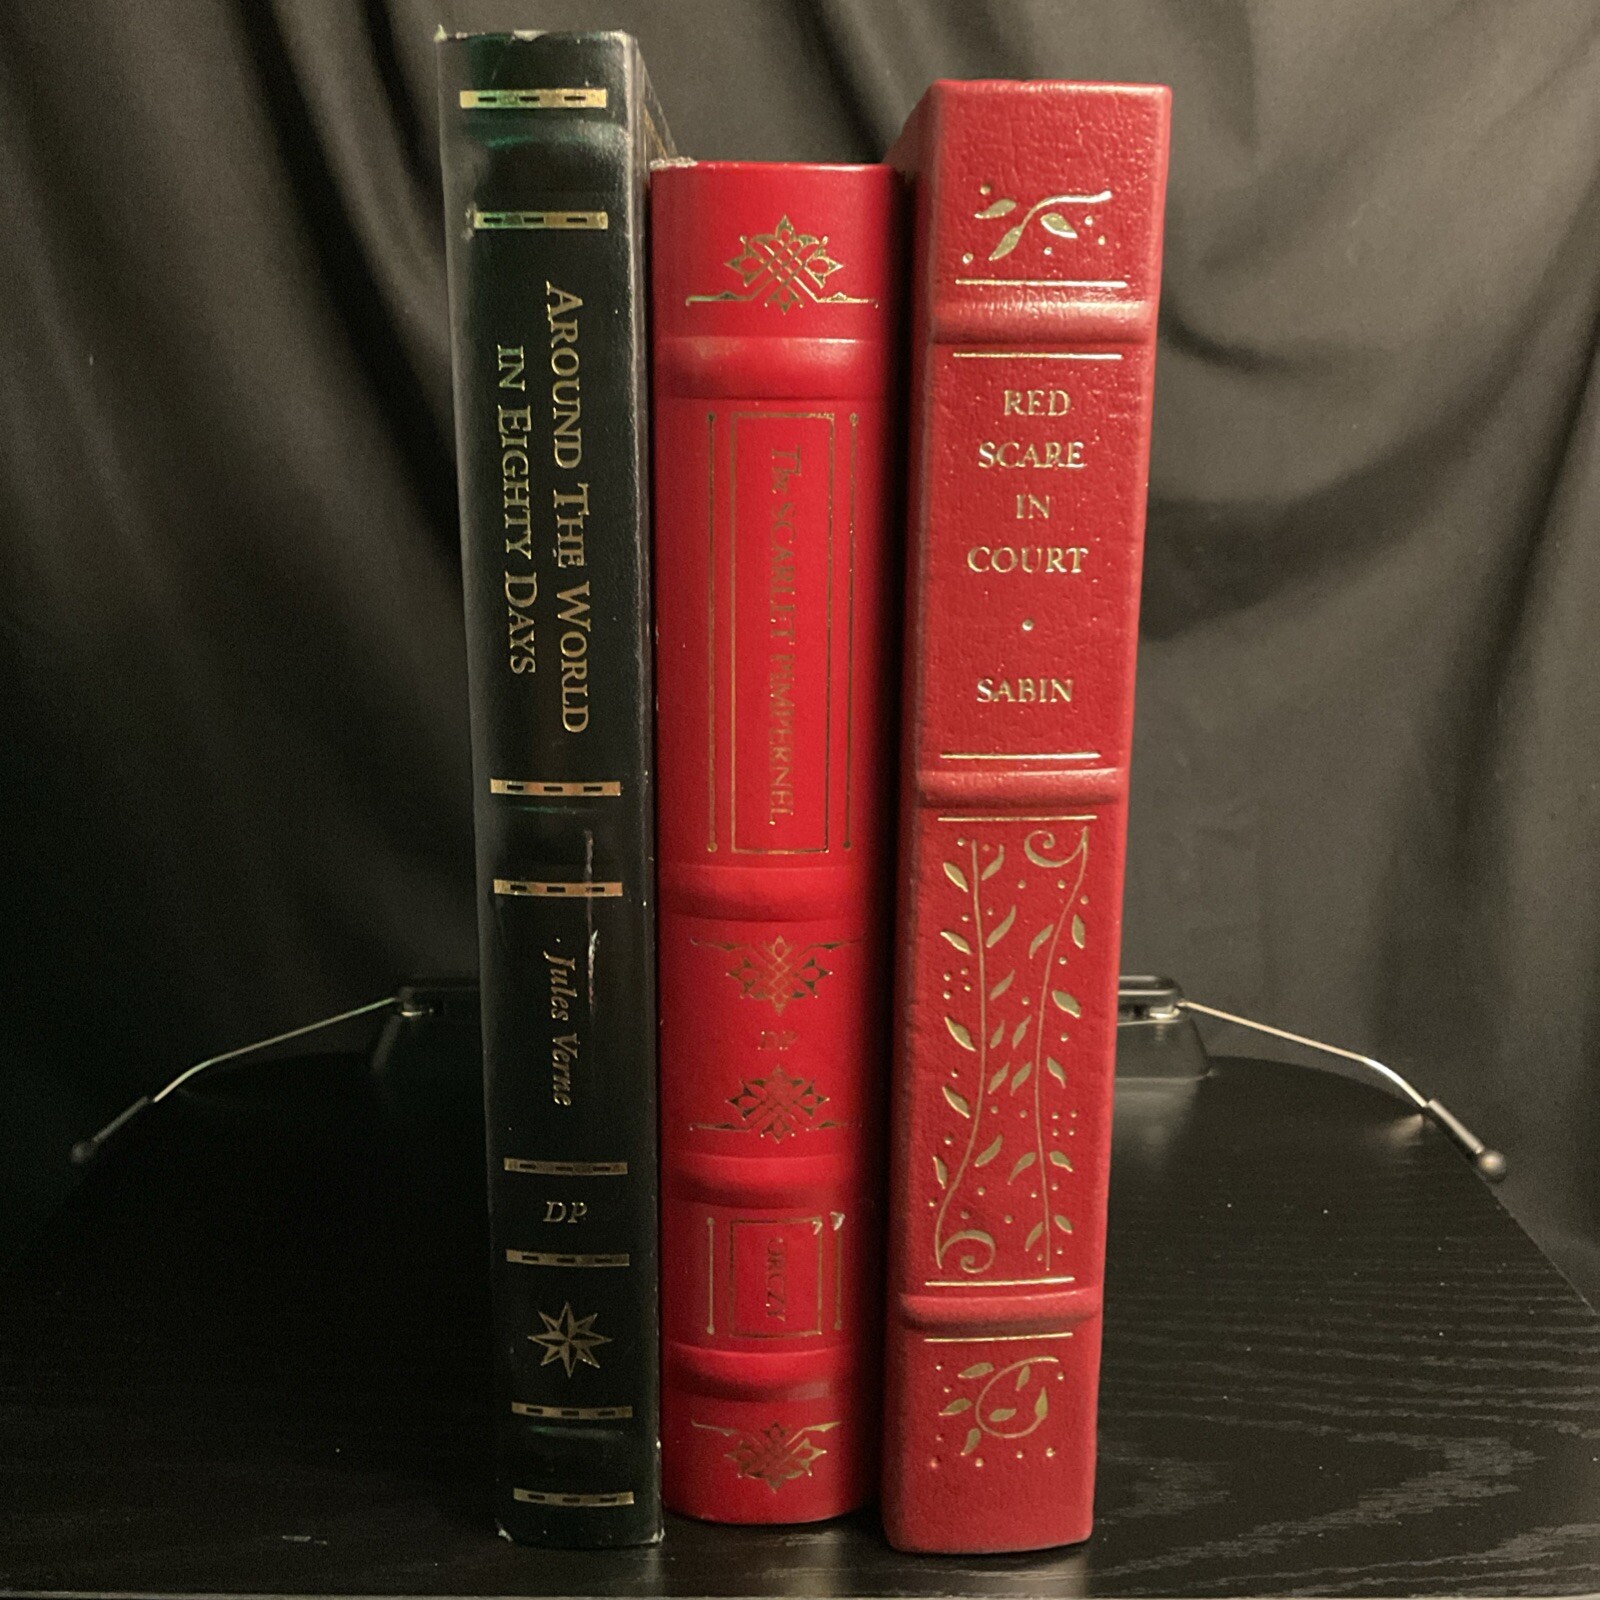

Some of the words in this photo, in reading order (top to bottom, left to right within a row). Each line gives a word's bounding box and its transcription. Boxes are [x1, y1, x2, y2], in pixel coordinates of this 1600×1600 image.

[497, 344, 525, 392] IN
[546, 280, 583, 469] AROUND
[1003, 389, 1072, 416] RED
[498, 405, 532, 560] EIGHTY
[772, 444, 801, 494] The
[978, 441, 1088, 468] SCARE
[553, 483, 590, 568] THE
[1016, 494, 1050, 519] IN
[770, 502, 796, 646] SCARLET
[967, 546, 1089, 573] COURT
[504, 571, 538, 675] DAYS
[557, 581, 592, 733] WORLD
[976, 677, 1073, 703] SABIN
[769, 653, 795, 826] PIMPERNEL
[543, 950, 578, 1021] Jules
[552, 1033, 580, 1106] Verne
[543, 1201, 588, 1223] DP
